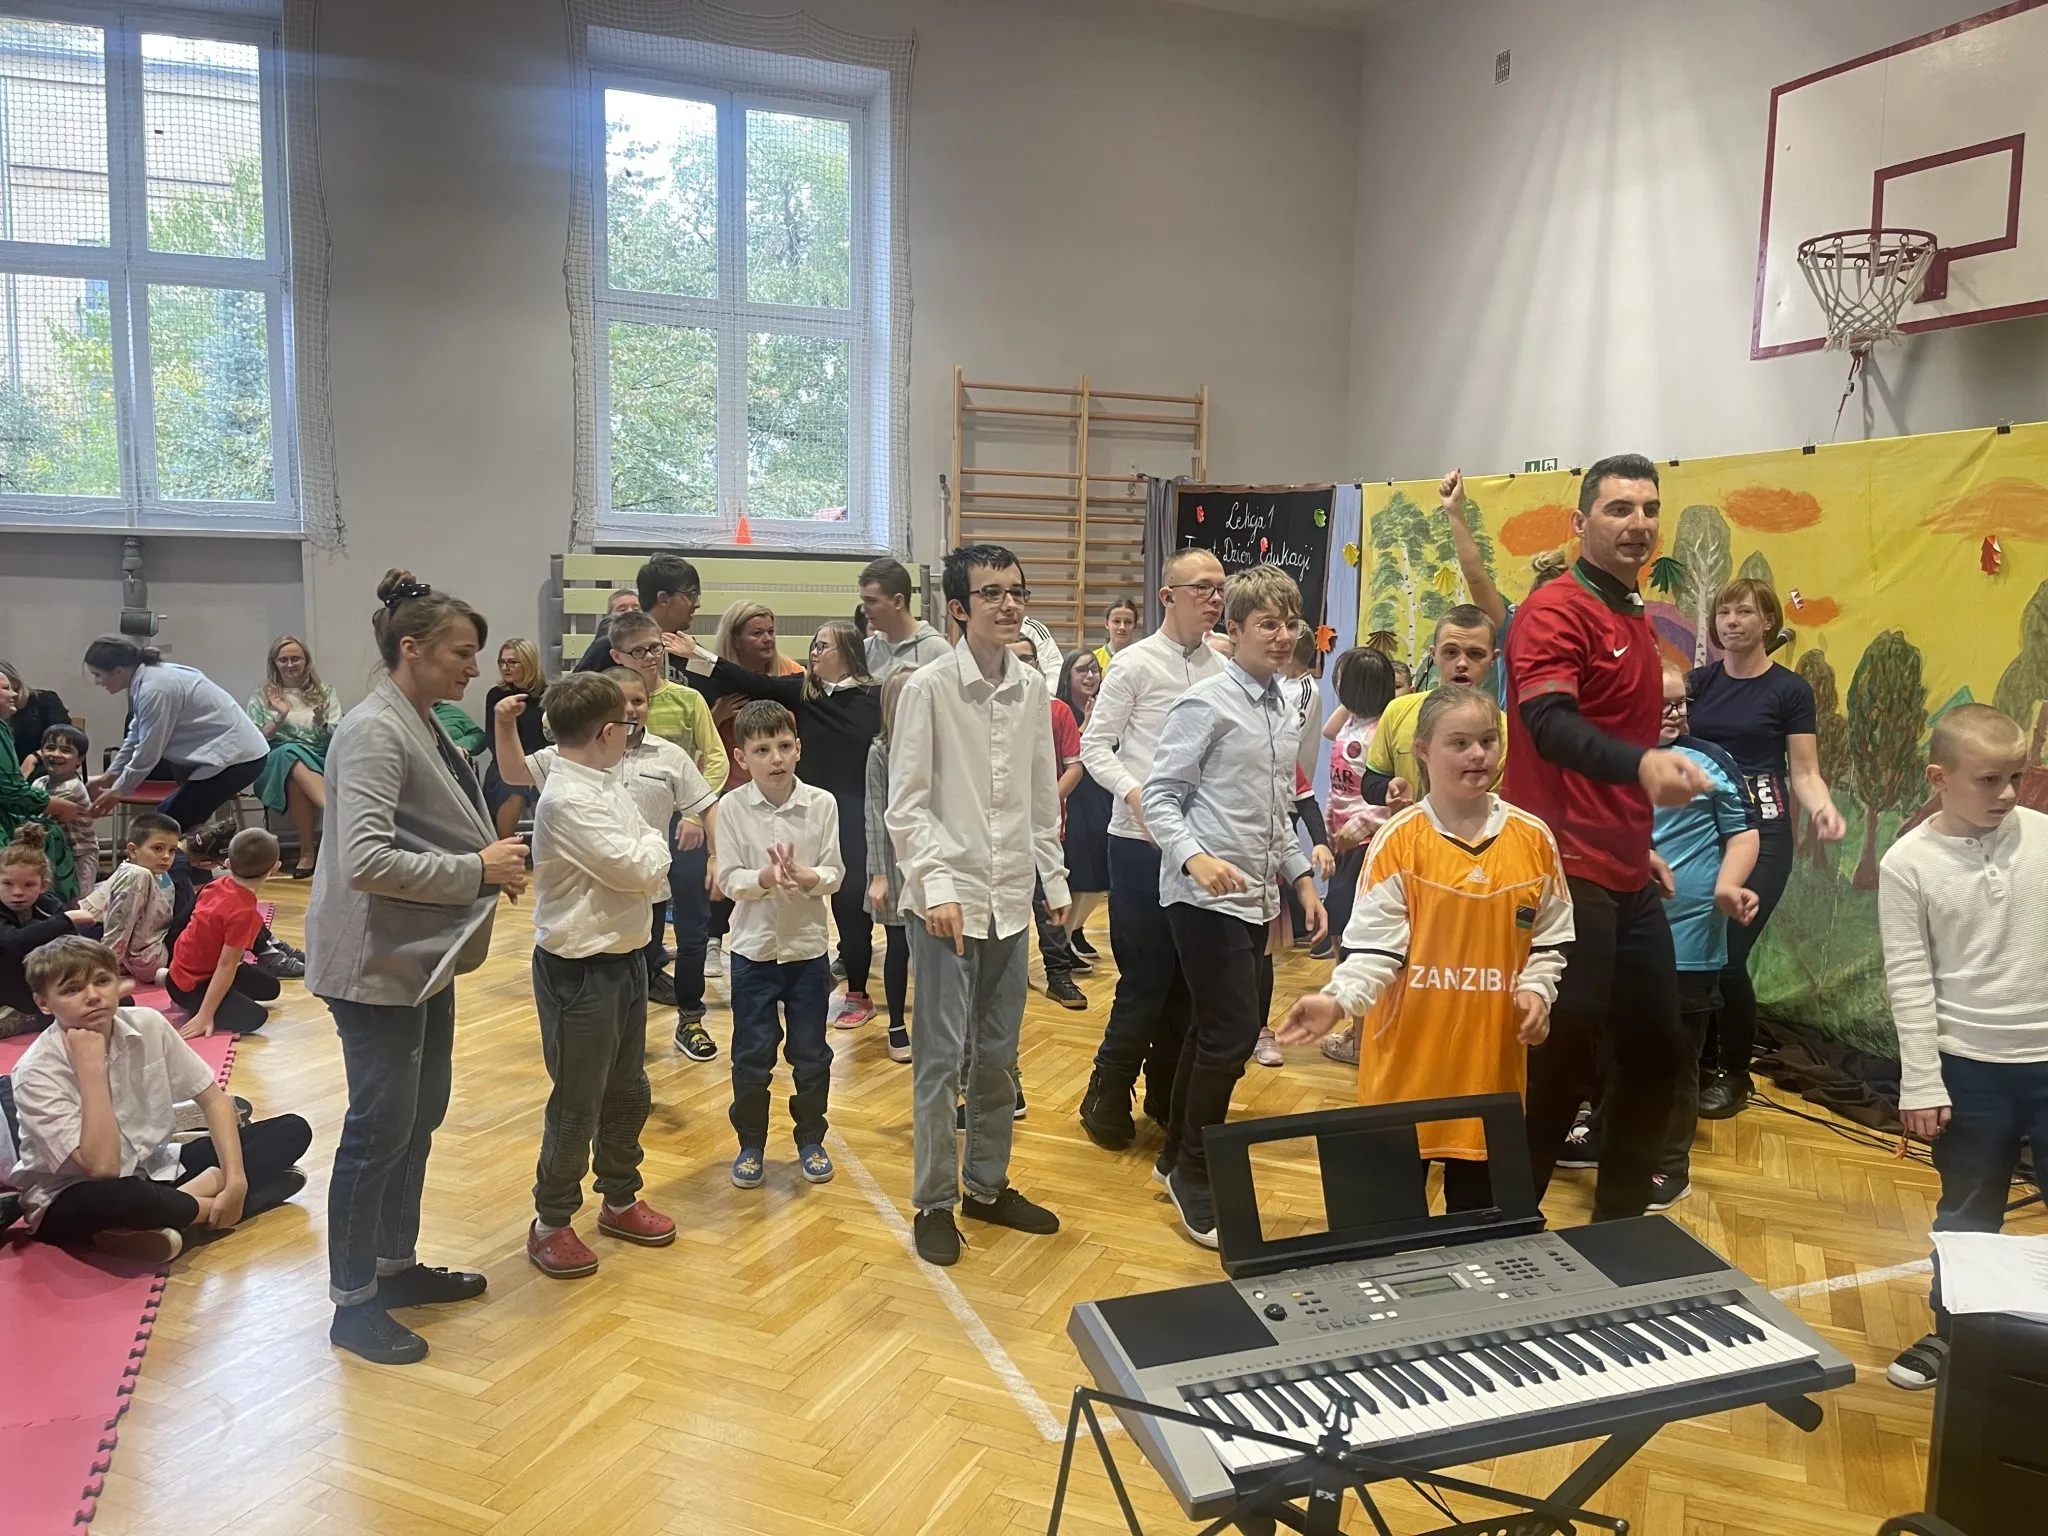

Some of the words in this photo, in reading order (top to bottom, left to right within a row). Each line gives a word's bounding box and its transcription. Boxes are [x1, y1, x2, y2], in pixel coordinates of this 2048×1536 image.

[1226, 501, 1266, 544] Lekcja
[1268, 504, 1275, 529] 1
[1223, 536, 1254, 565] Dzień
[1409, 965, 1518, 993] ZANZIB
[1315, 1489, 1336, 1502] FX
